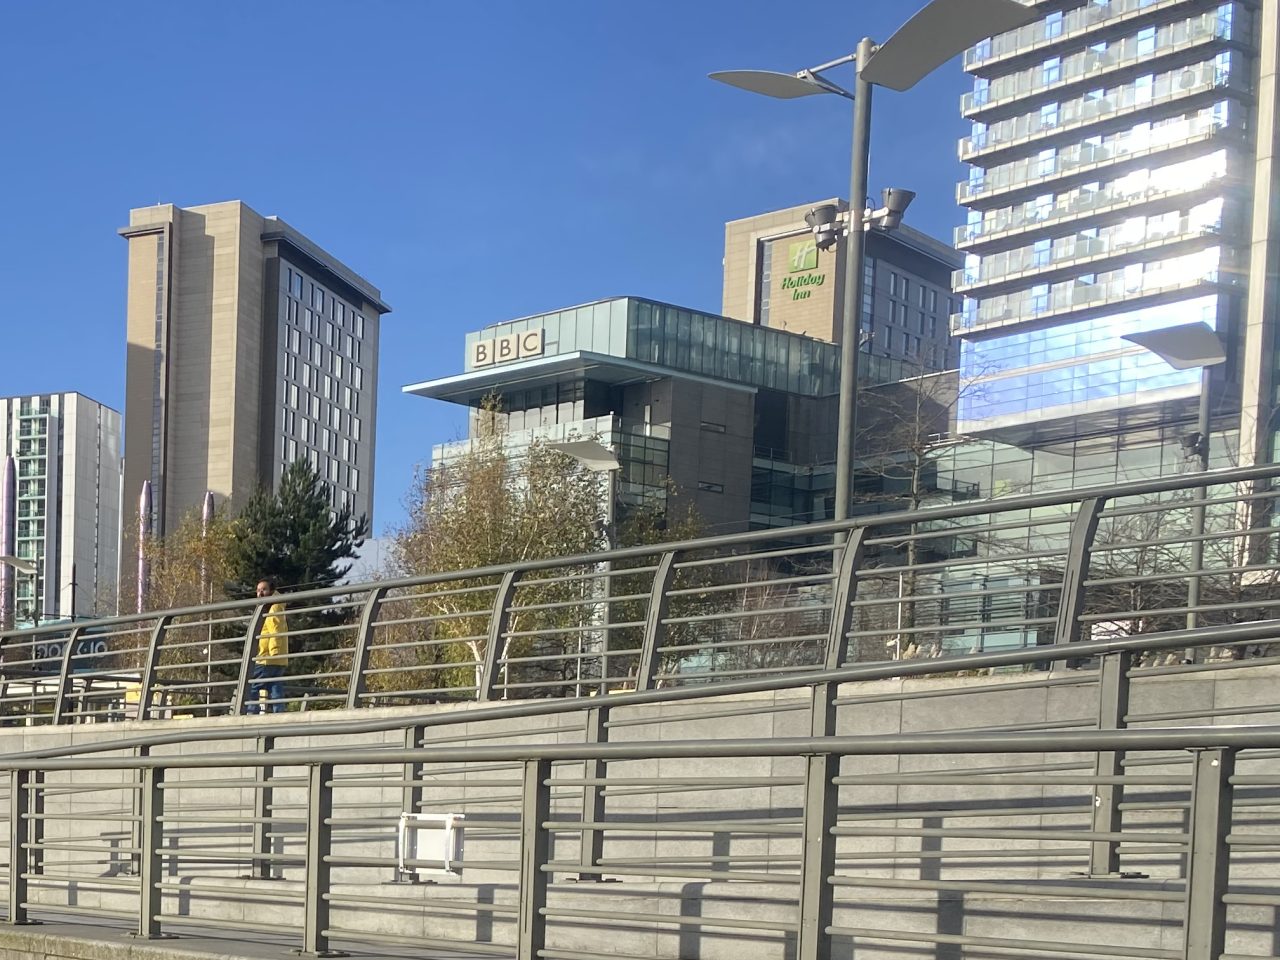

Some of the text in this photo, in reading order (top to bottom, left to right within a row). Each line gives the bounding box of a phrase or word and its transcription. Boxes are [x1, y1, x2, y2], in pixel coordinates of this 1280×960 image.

[781, 273, 826, 290] Holiday
[792, 289, 811, 301] Inn
[475, 333, 538, 363] BBC
